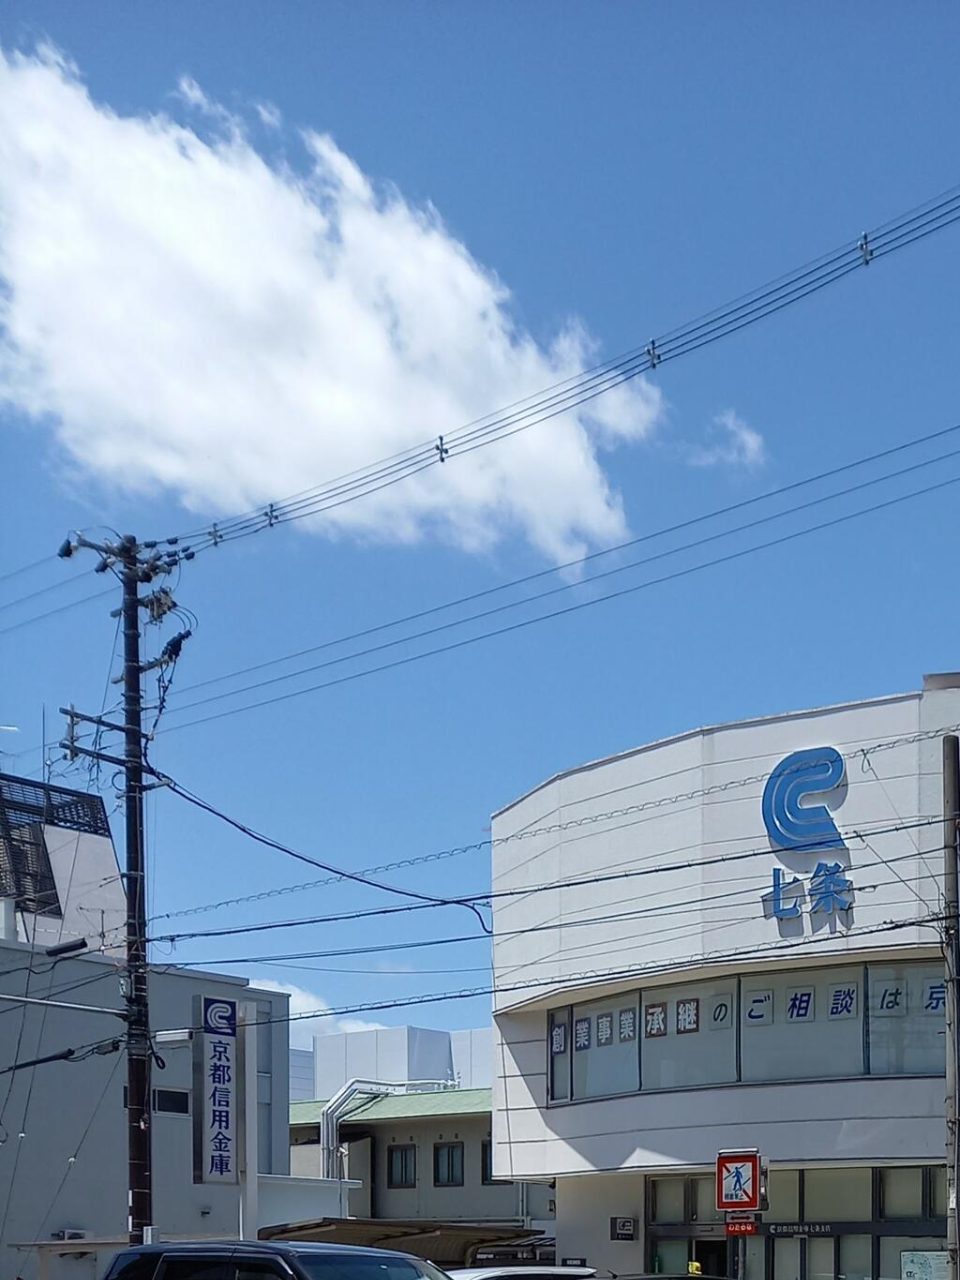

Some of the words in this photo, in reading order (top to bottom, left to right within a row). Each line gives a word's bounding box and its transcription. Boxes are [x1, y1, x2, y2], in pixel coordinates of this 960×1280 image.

[760, 862, 853, 918] 七条
[208, 1040, 232, 1176] 京都信用金庫
